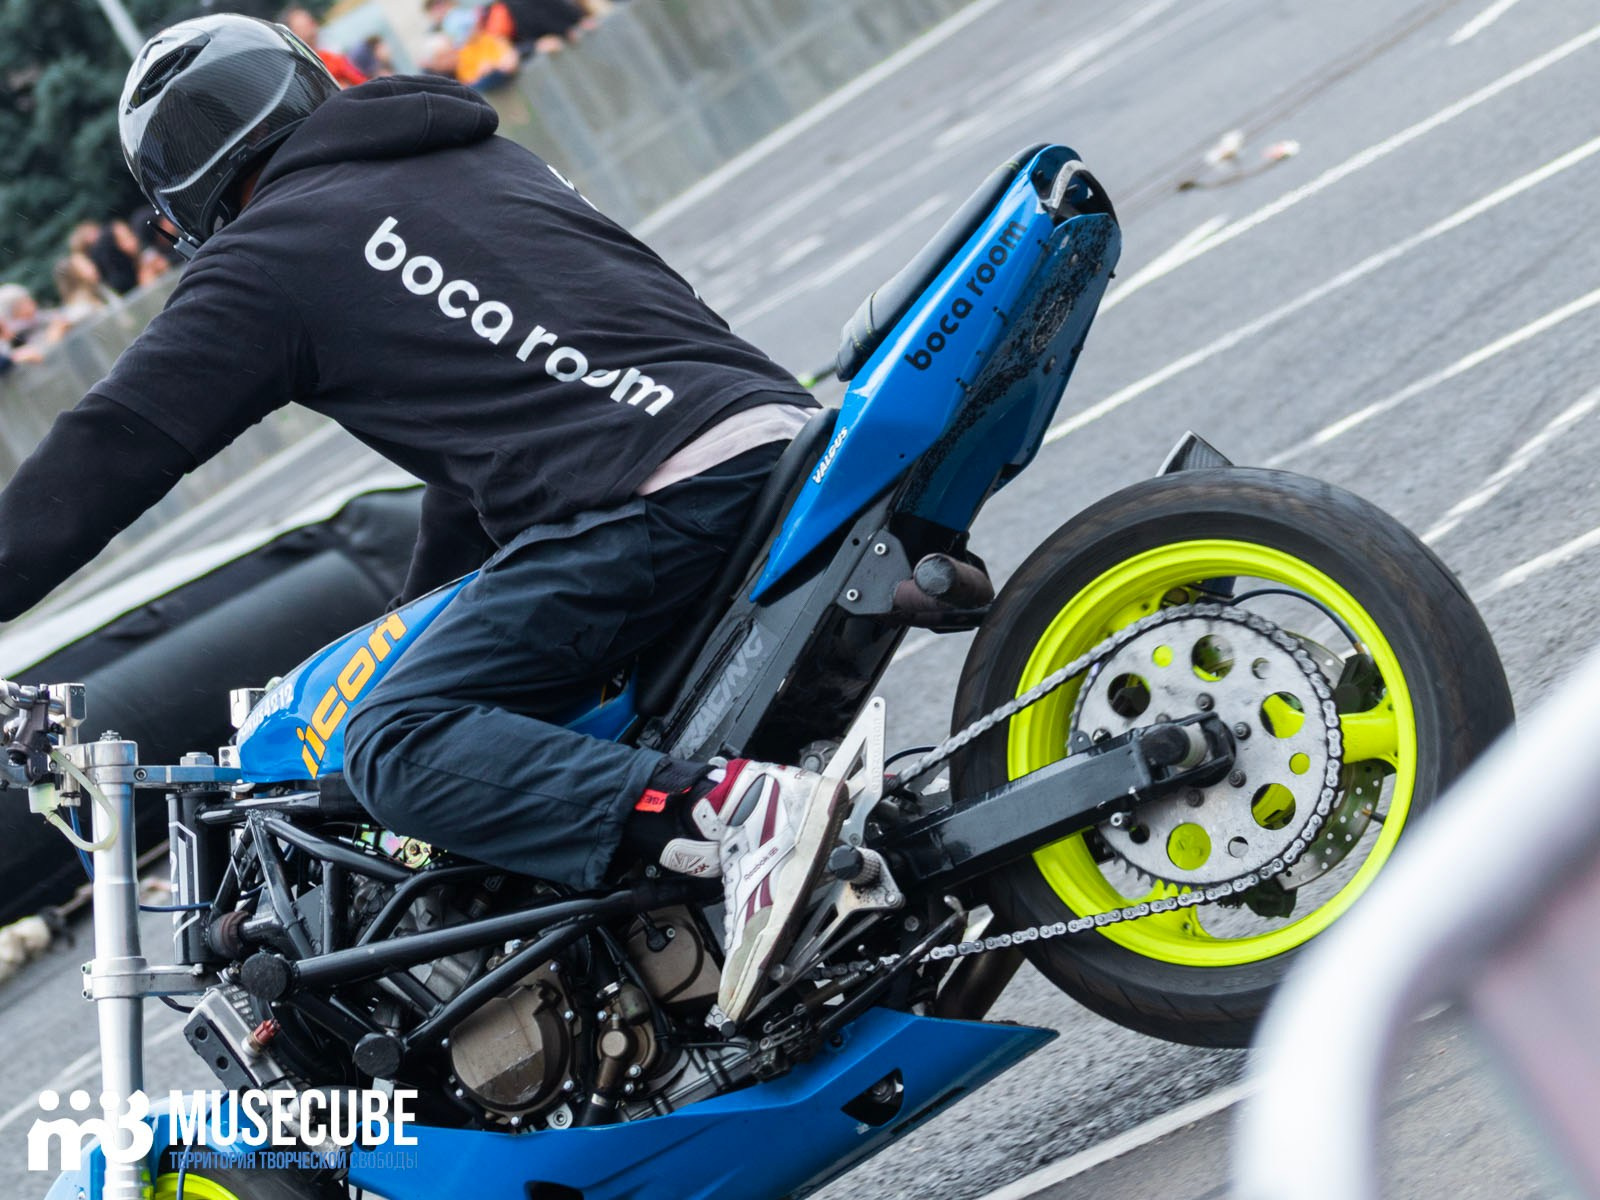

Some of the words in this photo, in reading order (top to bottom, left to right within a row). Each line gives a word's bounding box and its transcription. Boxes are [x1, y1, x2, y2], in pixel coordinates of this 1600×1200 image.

[364, 216, 514, 345] boca
[904, 298, 974, 371] boca
[966, 220, 1027, 296] room
[297, 613, 407, 779] icon
